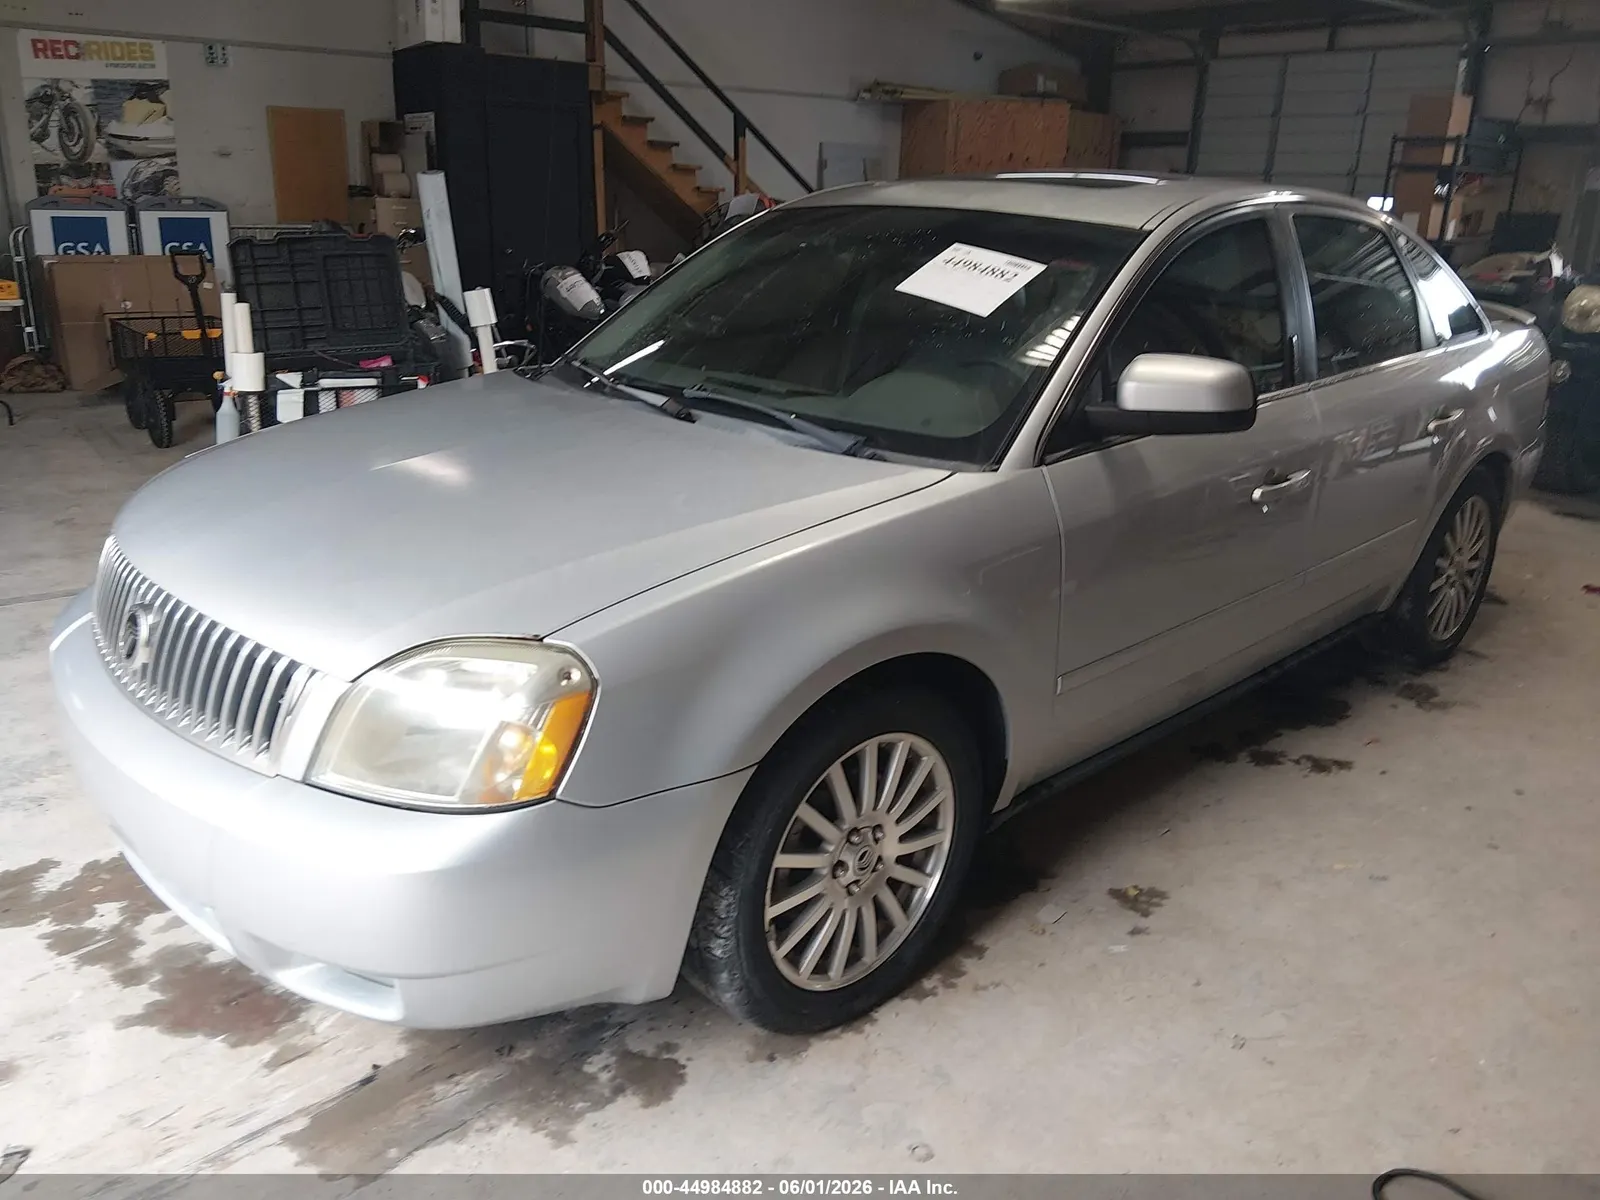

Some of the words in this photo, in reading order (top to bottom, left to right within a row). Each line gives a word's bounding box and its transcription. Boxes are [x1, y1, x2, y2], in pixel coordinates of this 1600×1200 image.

[30, 38, 81, 60] REC
[84, 41, 156, 61] RIDES
[57, 242, 106, 256] GSA
